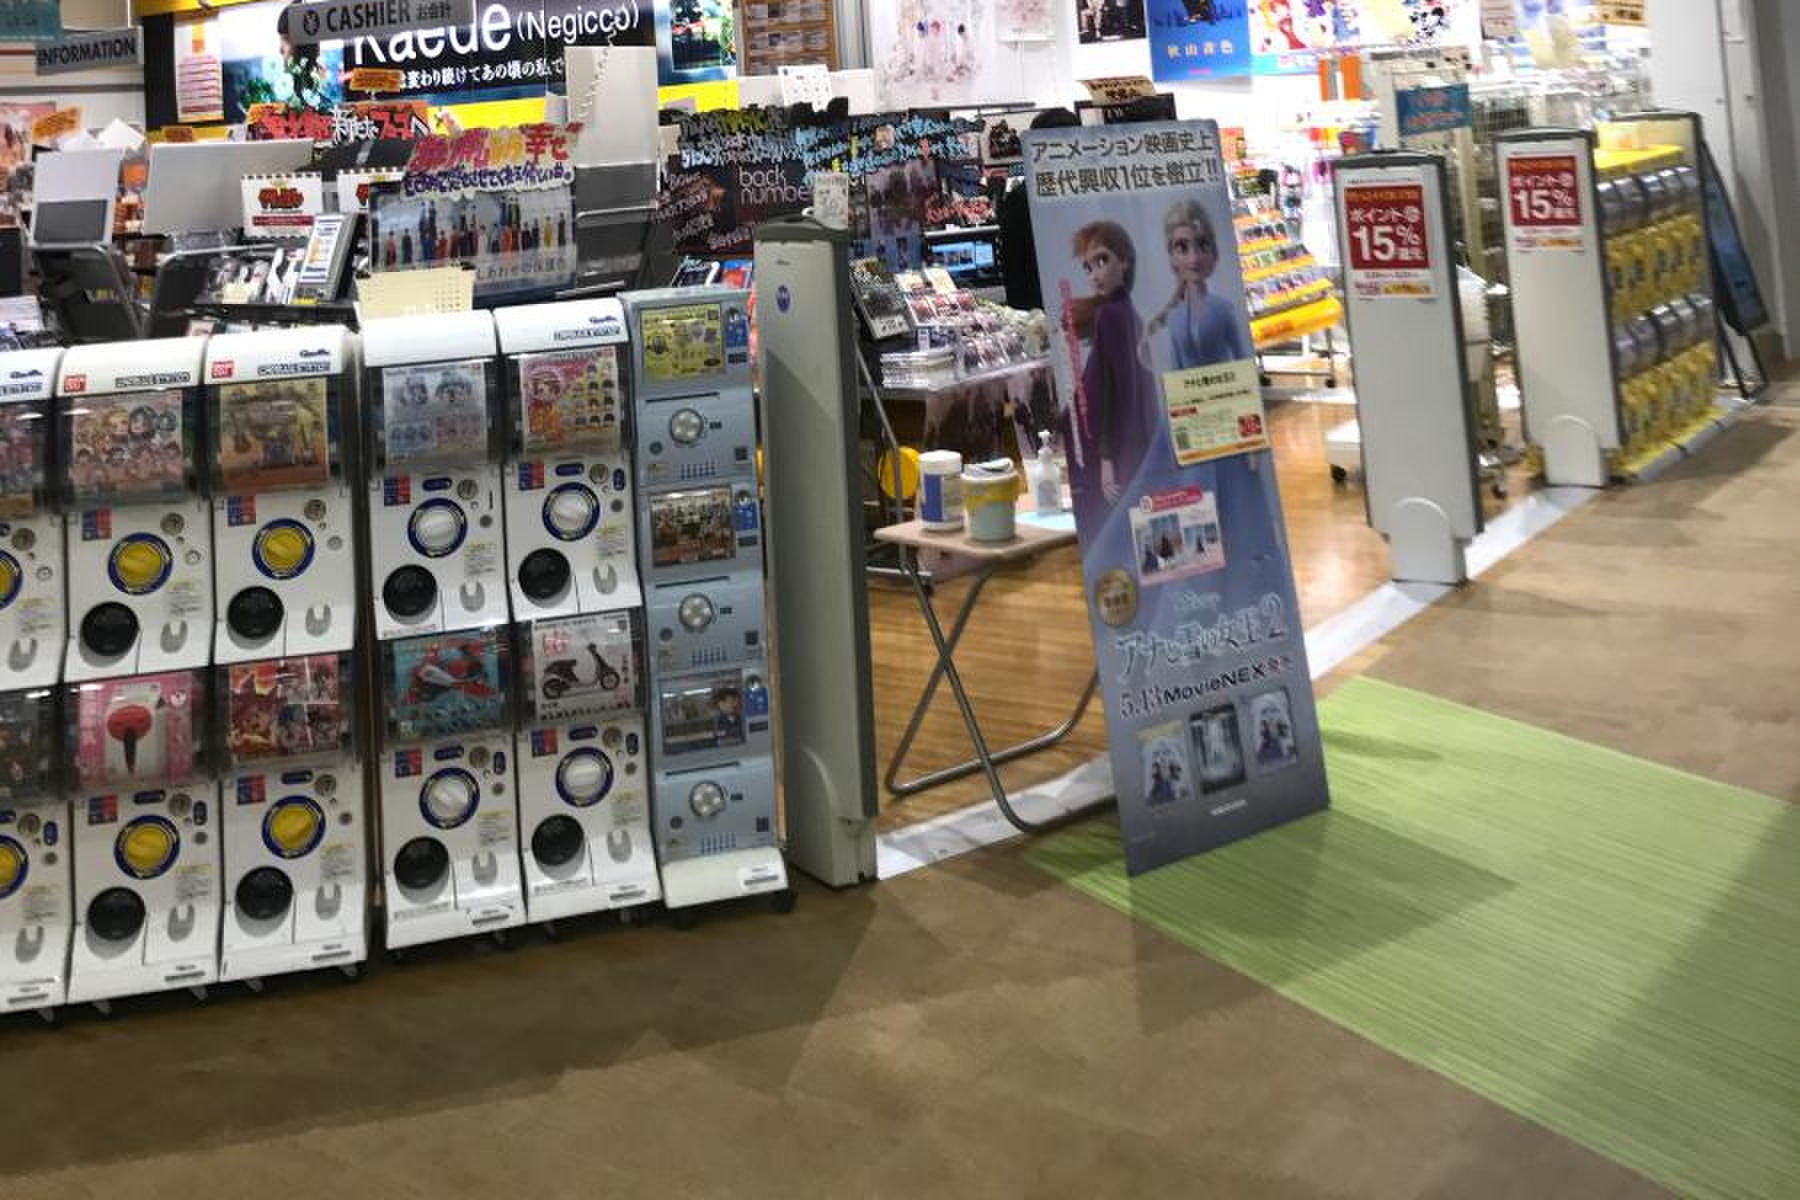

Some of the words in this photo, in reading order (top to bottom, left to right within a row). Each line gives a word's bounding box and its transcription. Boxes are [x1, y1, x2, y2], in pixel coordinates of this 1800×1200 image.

[326, 0, 411, 31] CASHIER
[38, 37, 136, 66] INFORMATION
[1031, 130, 1213, 162] アニメーション映画史上
[739, 165, 786, 188] back
[740, 184, 810, 205] numbe
[1351, 224, 1423, 262] 15%
